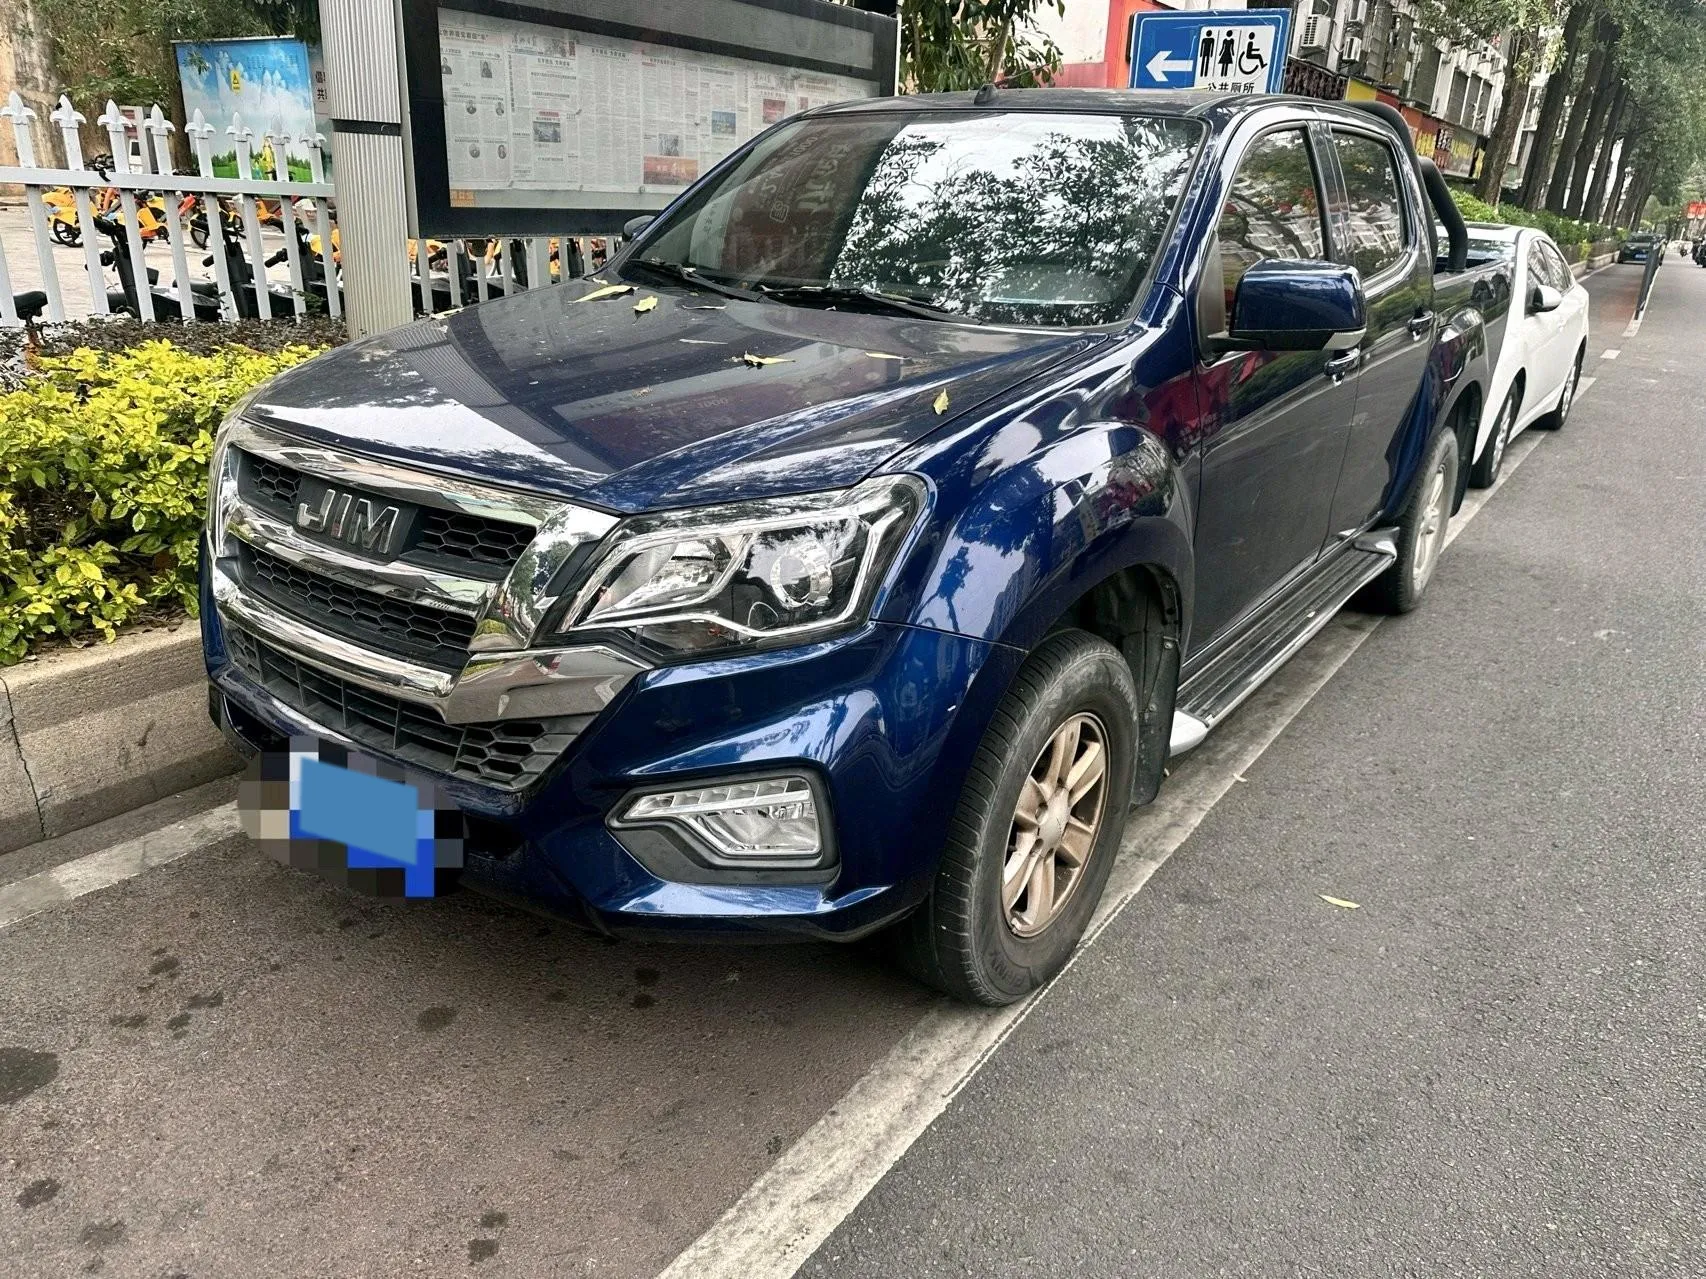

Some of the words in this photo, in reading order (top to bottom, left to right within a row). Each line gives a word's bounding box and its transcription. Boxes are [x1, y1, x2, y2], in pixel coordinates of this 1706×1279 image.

[1208, 82, 1255, 94] 公共厕所
[297, 489, 399, 554] JIM
